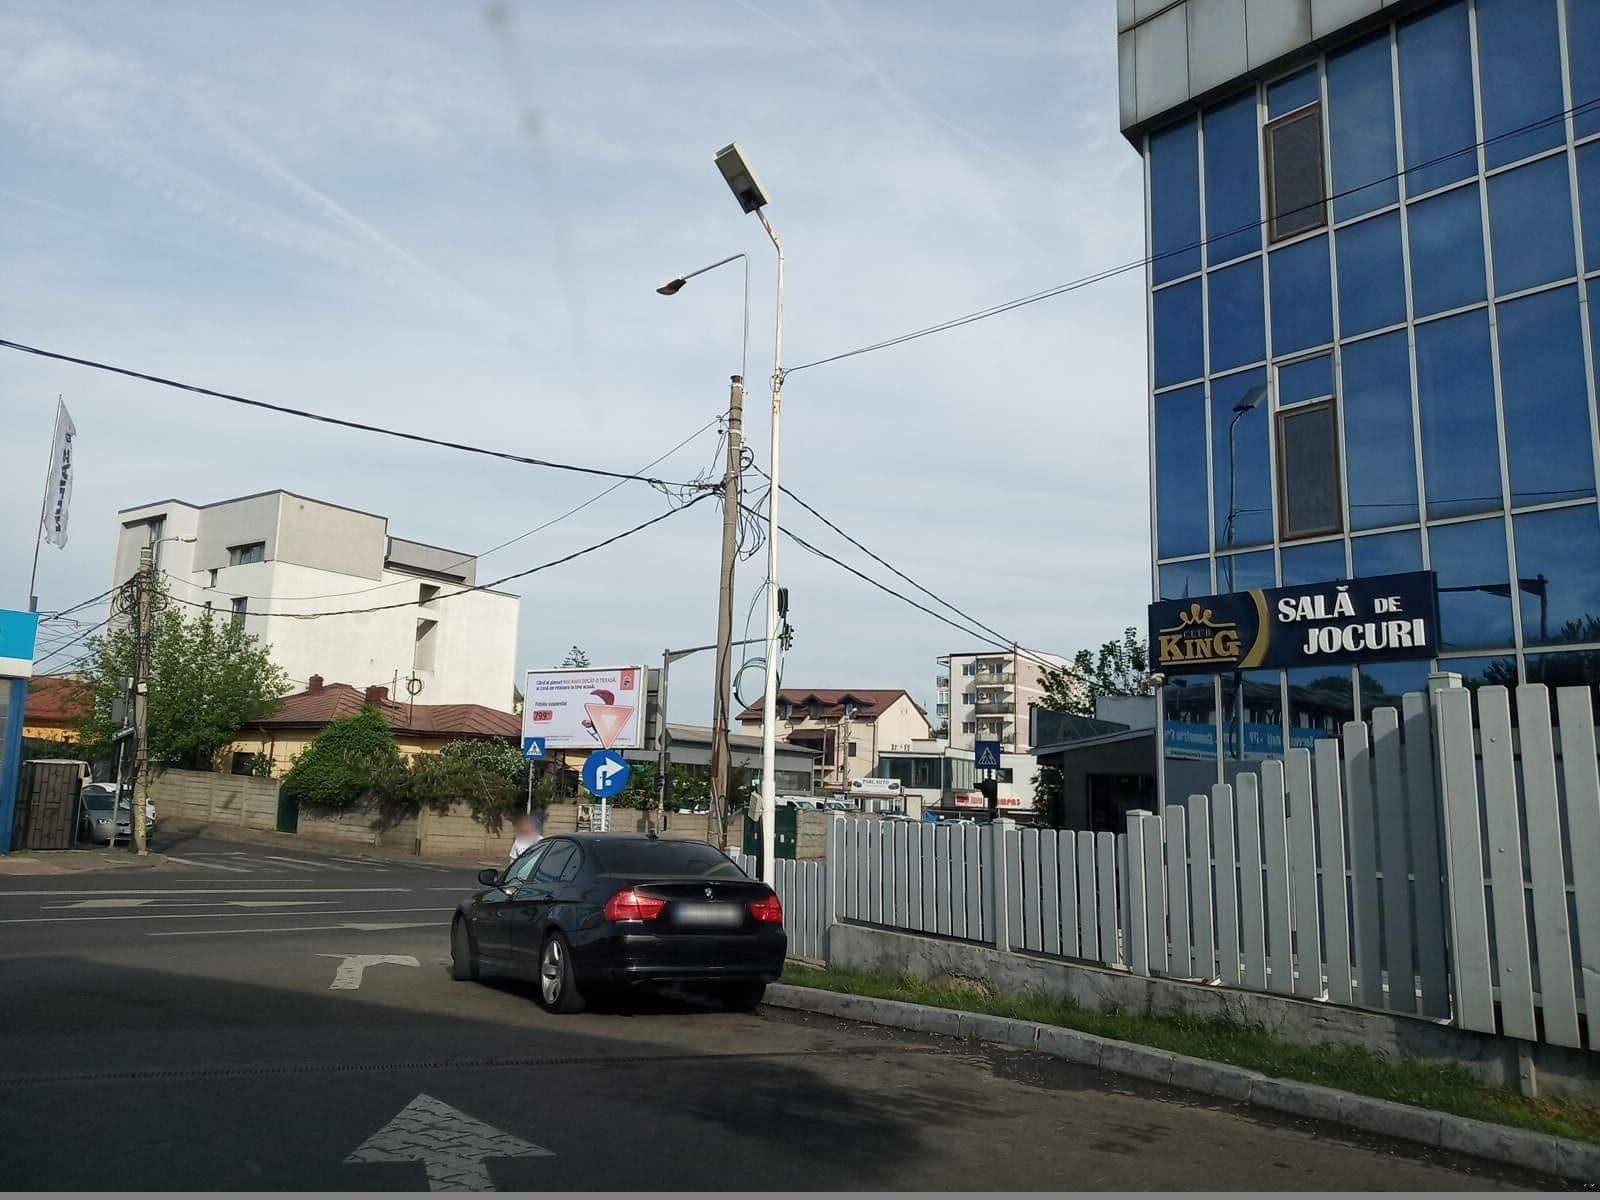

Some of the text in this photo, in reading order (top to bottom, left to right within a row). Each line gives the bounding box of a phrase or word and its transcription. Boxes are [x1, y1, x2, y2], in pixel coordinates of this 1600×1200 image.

[1278, 585, 1403, 623] SALĂ DE
[1158, 630, 1241, 661] KING
[1303, 618, 1426, 656] JOCURI
[534, 711, 547, 721] 799
